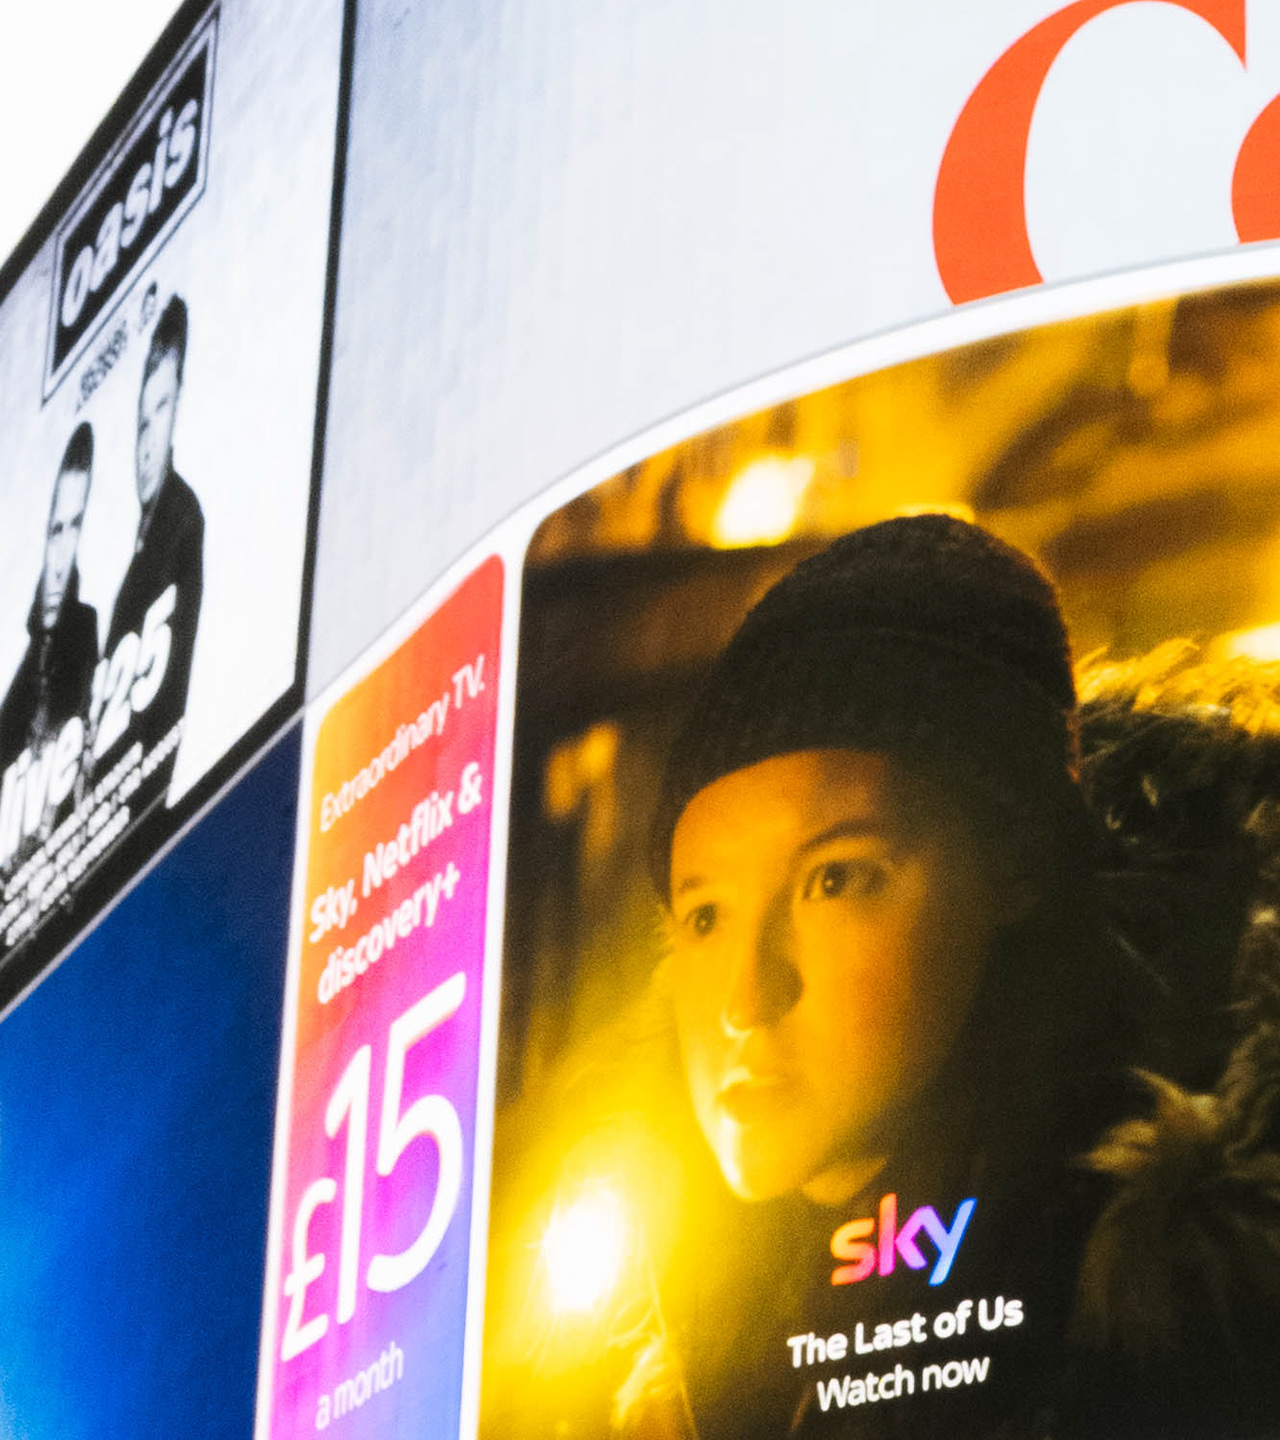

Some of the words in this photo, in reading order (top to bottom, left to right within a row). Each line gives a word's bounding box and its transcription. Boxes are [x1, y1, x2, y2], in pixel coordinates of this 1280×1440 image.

[62, 94, 198, 329] oasis
[320, 692, 450, 833] Extraordinary
[453, 653, 485, 709] TV.
[363, 790, 454, 898] Netflix
[458, 762, 482, 815] &
[317, 861, 460, 1004] discovery+
[281, 971, 466, 1361] £15
[830, 1192, 978, 1287] sky
[315, 1394, 330, 1431] a
[332, 1341, 405, 1420] month
[787, 1332, 848, 1368] The
[855, 1313, 927, 1355] Last
[933, 1300, 974, 1339] of
[978, 1296, 1024, 1331] Us
[817, 1364, 915, 1411] Watch
[922, 1357, 990, 1392] now
